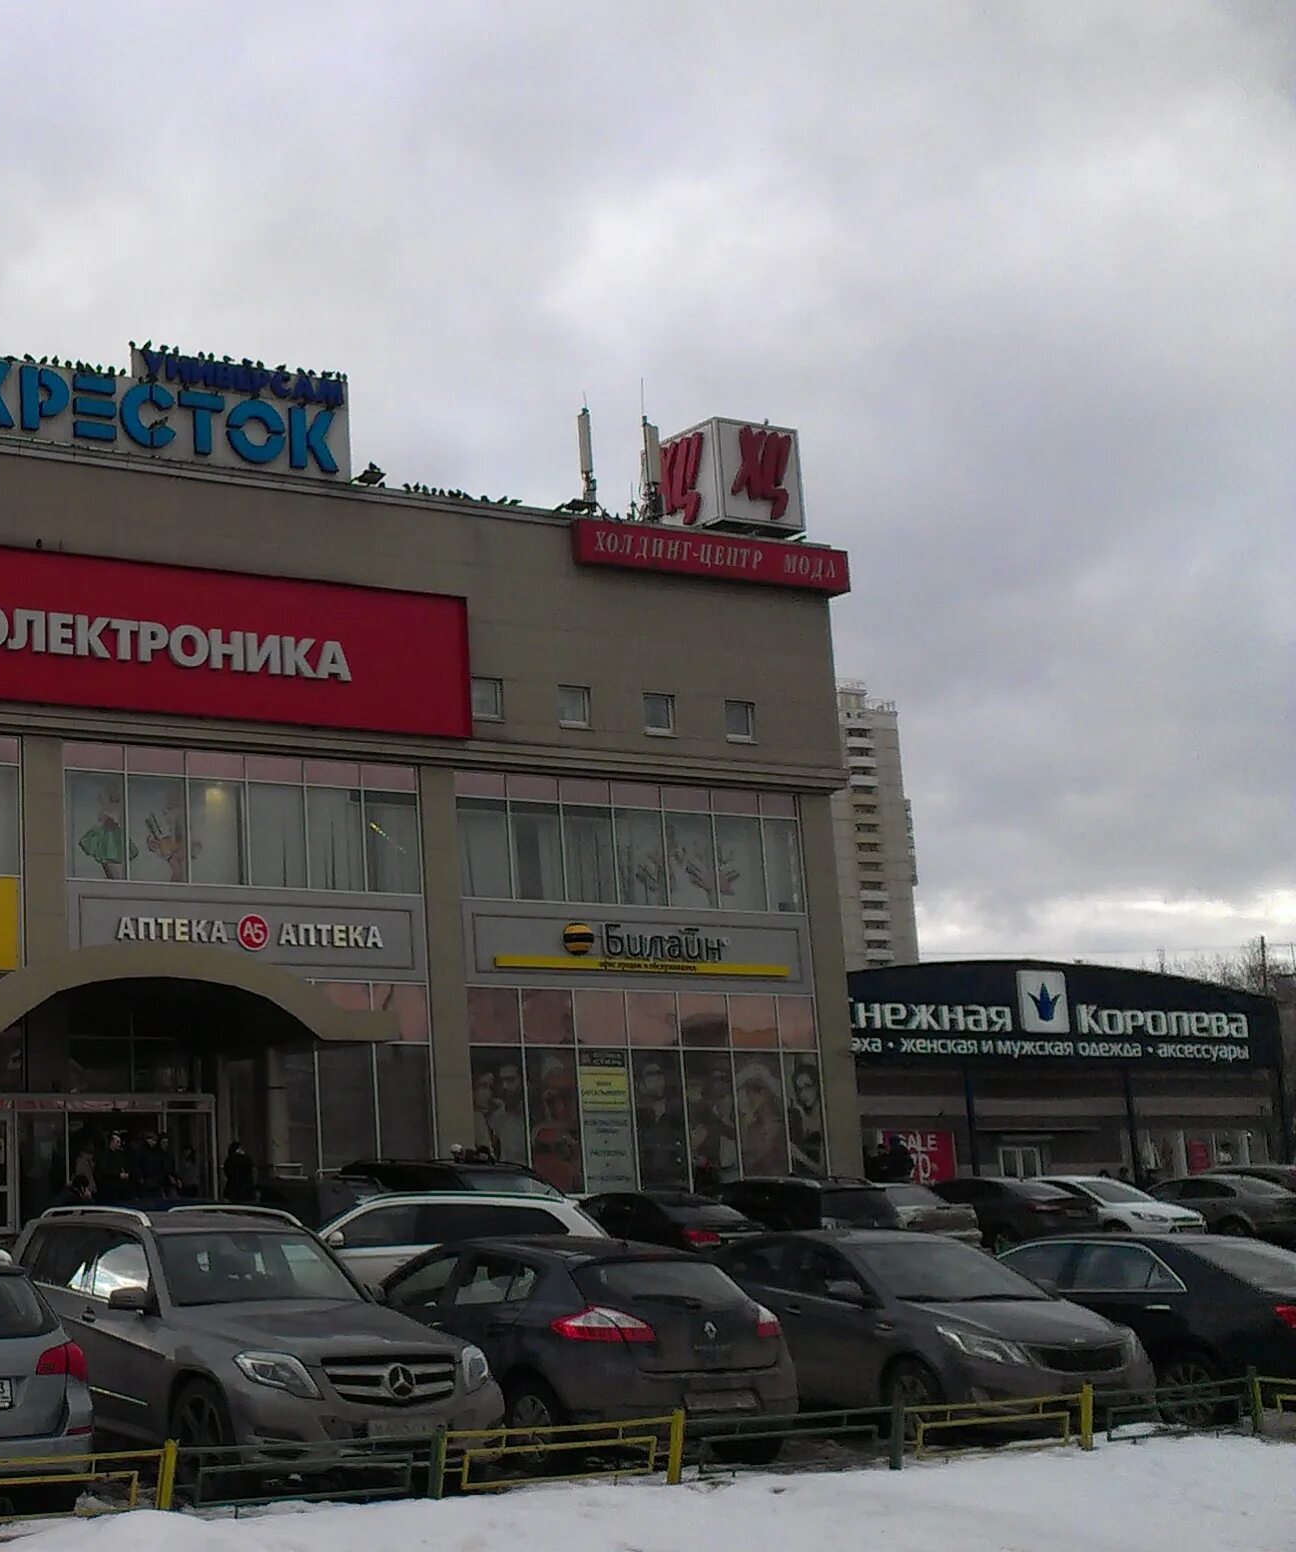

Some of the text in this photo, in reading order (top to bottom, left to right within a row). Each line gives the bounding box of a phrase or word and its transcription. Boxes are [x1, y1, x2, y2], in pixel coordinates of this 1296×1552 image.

[595, 531, 837, 580] ХОЛДИНГ-ЦЕНТР МОДА
[116, 916, 384, 949] АПТЕКА А5 АПТЕКА
[602, 923, 722, 961] Билайн
[848, 997, 1249, 1039] нежная Королева
[901, 1037, 978, 1055] женская
[981, 1040, 994, 1055] и
[998, 1039, 1074, 1059] мужская
[1079, 1041, 1142, 1058] одежда
[1157, 1042, 1250, 1063] аксессуары
